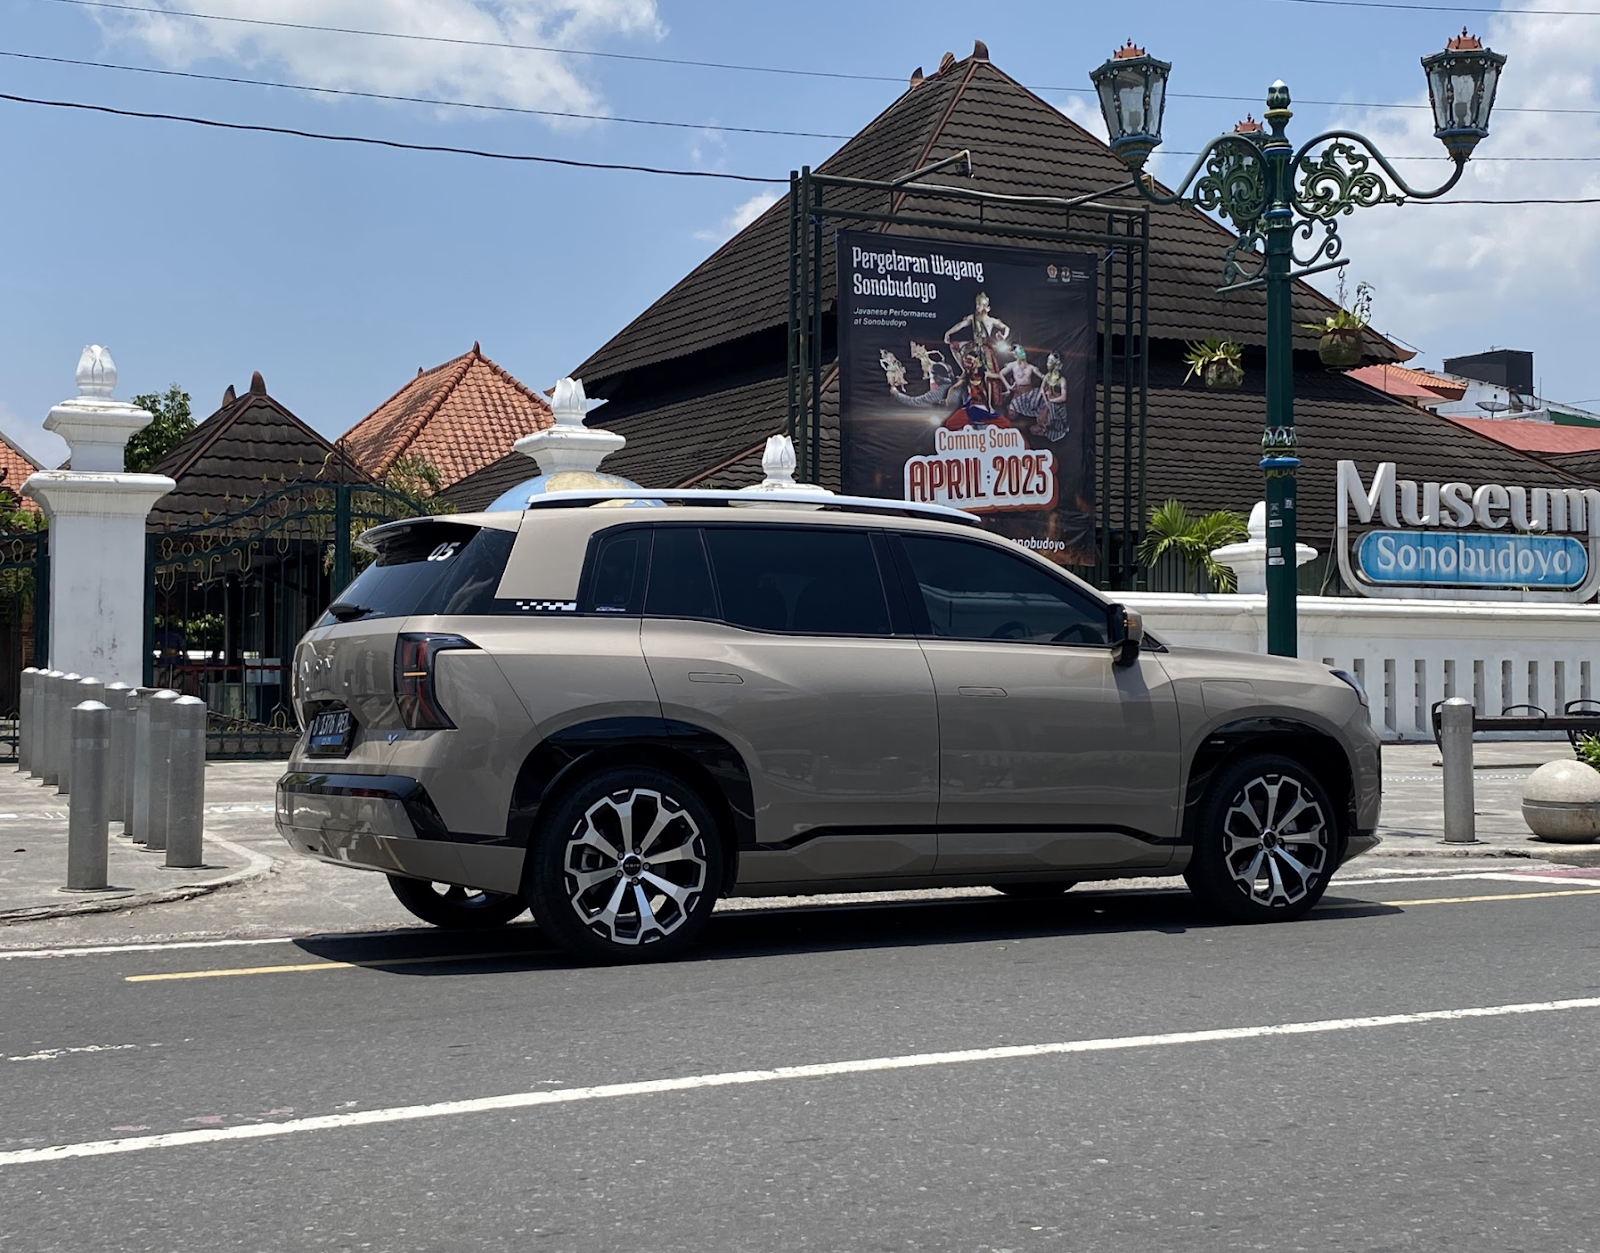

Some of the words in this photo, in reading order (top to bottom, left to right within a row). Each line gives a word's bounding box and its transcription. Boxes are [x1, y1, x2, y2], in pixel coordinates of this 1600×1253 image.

[852, 246, 930, 275] Pergelaran
[930, 253, 985, 283] Wayang
[853, 273, 937, 303] Sonobudoyo
[853, 306, 888, 316] Javanese
[888, 308, 937, 319] Performances
[853, 318, 862, 326] at
[862, 317, 907, 328] Sonobudoyo
[938, 428, 987, 453] Coming
[989, 428, 1019, 448] Soon
[908, 457, 987, 503] APRIL
[992, 454, 1049, 497] 2025
[1337, 459, 1600, 532] Museum
[427, 541, 461, 561] 05
[1377, 536, 1572, 581] Sonobudoyo
